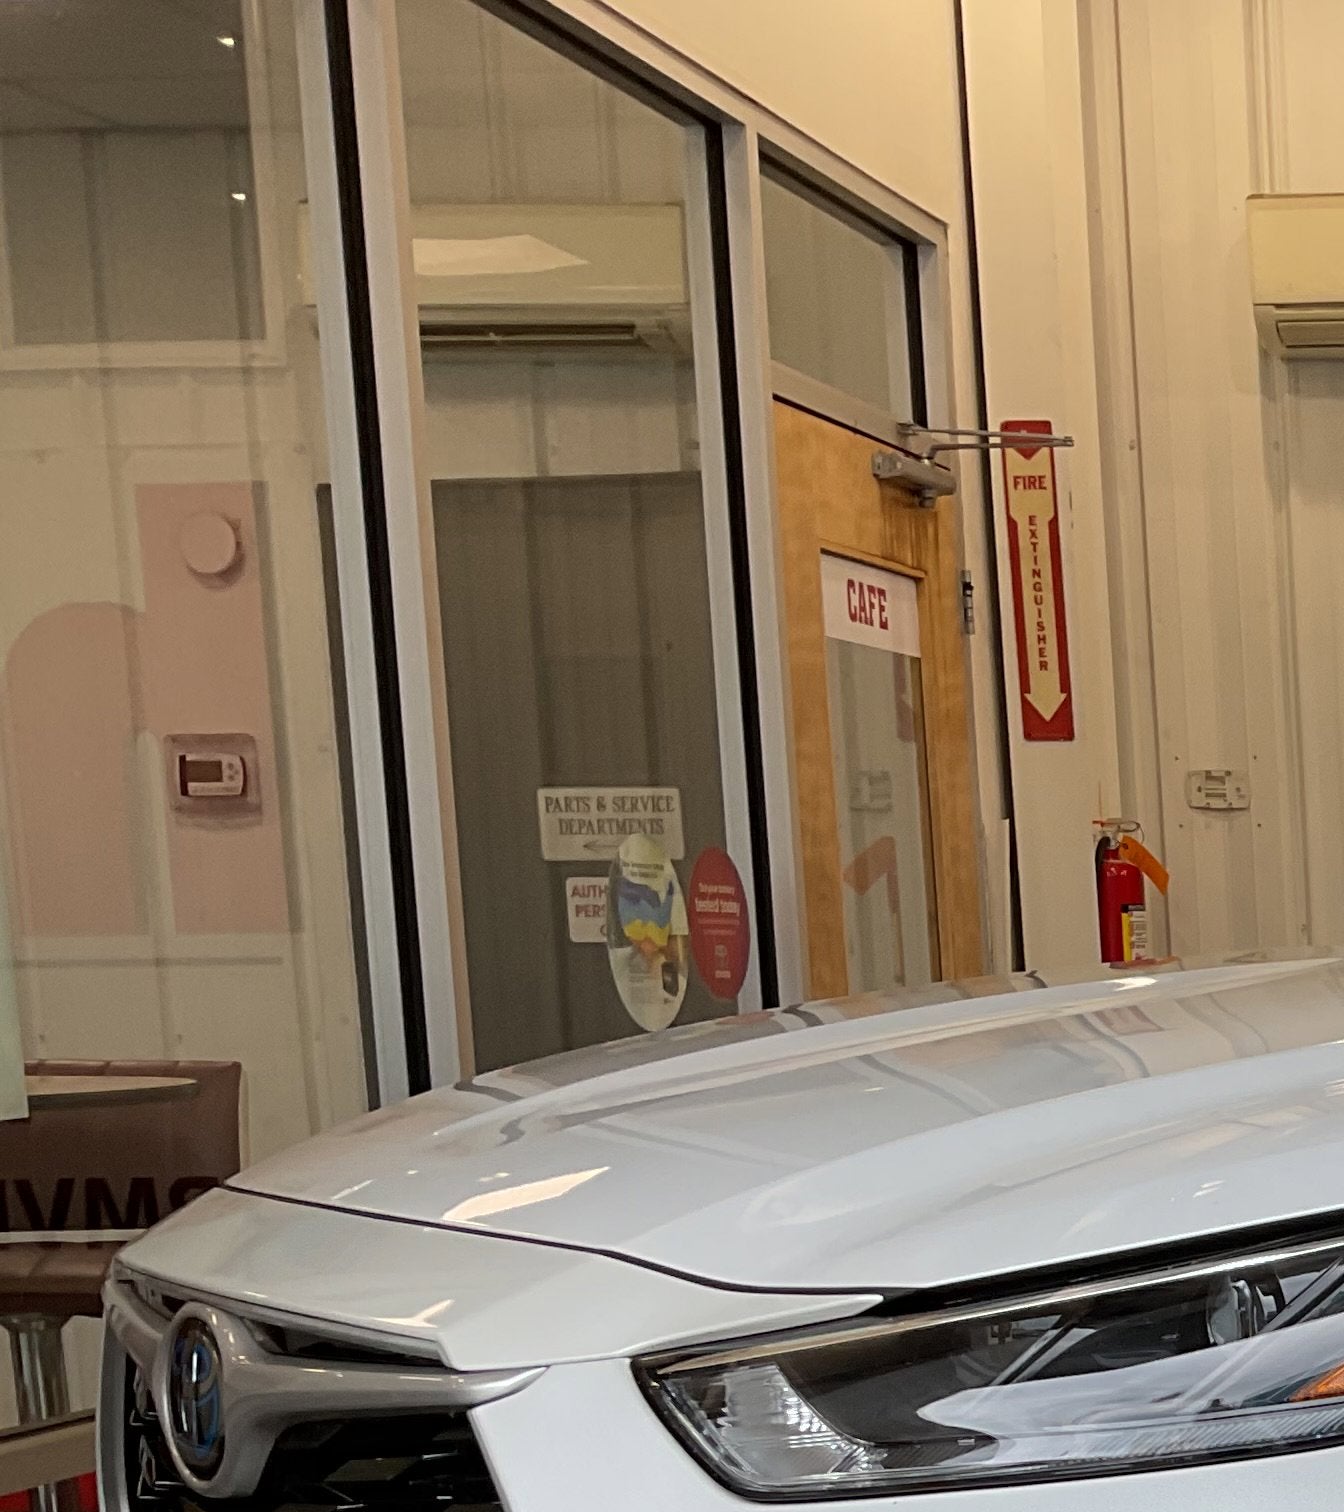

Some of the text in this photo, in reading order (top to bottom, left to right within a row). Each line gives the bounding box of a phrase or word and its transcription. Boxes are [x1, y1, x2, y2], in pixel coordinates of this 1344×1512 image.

[1012, 474, 1048, 491] FIRE
[1027, 514, 1049, 672] EXTINGUISHER
[846, 577, 890, 631] CAFE
[544, 795, 675, 814] PARTS & SERVICE
[558, 817, 665, 836] DEPARTMENTS
